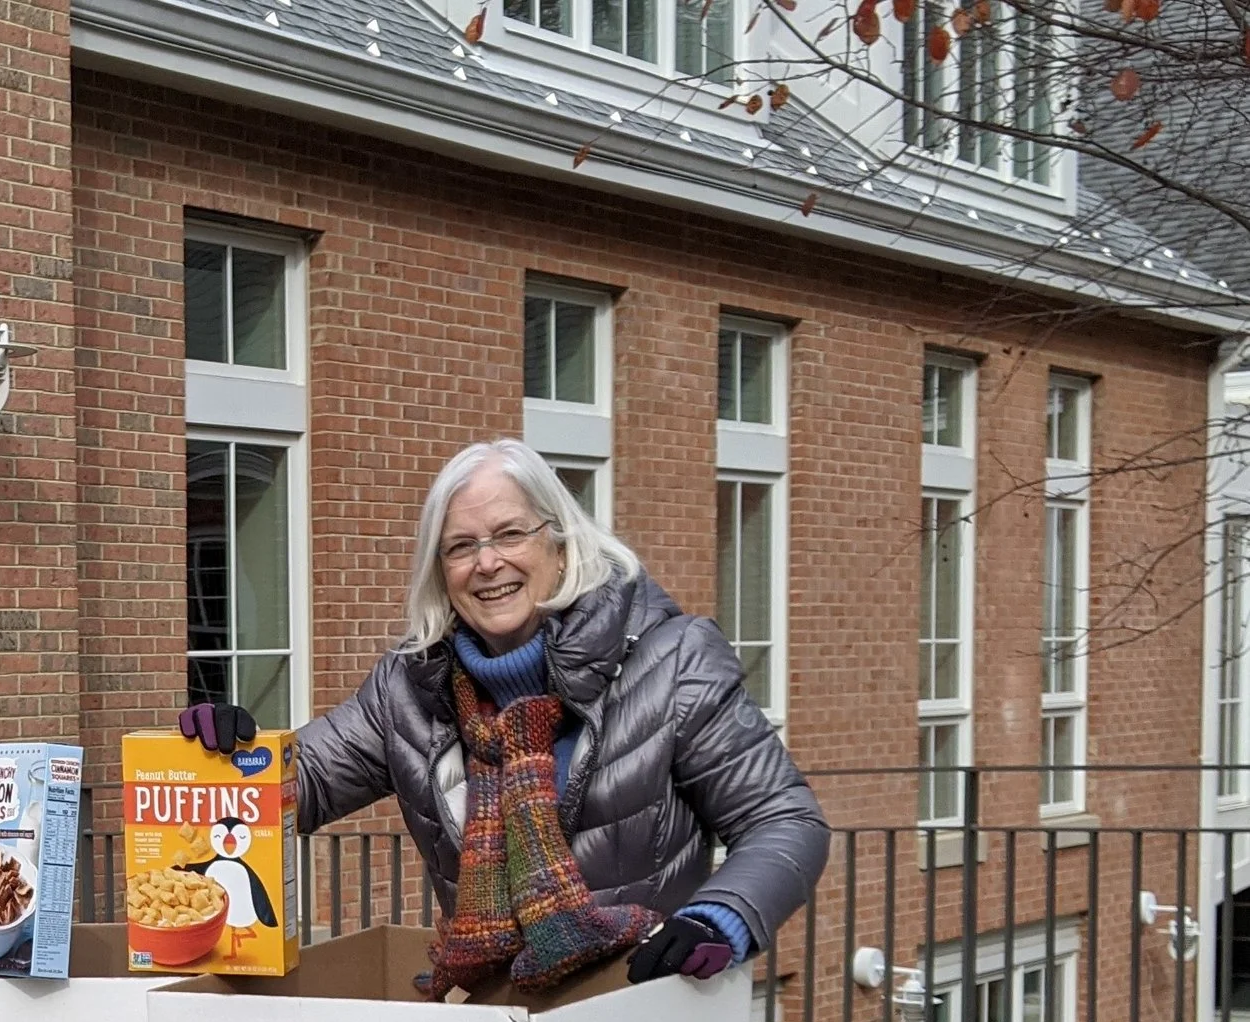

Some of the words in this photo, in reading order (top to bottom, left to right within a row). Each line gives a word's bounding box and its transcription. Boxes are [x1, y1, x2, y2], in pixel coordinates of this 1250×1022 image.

[237, 755, 266, 767] BARBARA'S
[135, 769, 165, 780] Peanut
[168, 770, 197, 781] Butter
[134, 785, 261, 823] PUFFINS
